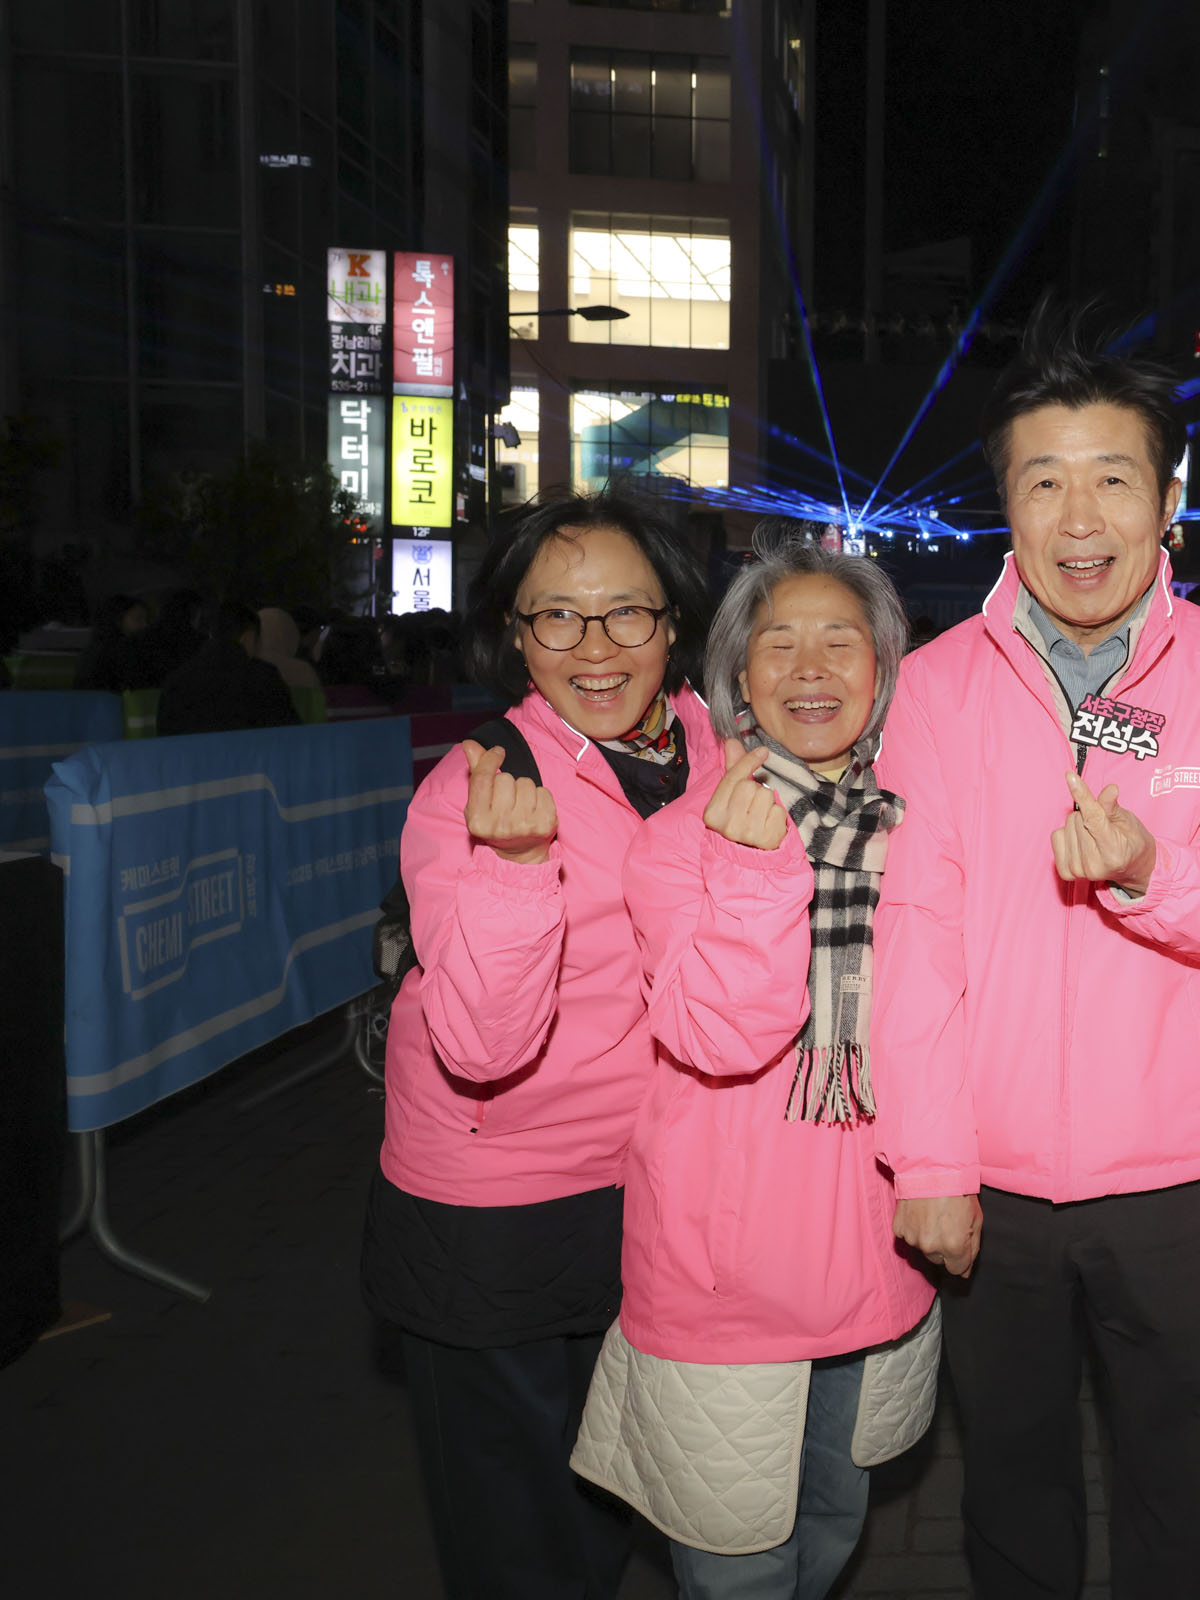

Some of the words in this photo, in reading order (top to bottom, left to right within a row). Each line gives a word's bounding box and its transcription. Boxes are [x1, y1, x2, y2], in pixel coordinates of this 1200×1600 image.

[347, 253, 371, 277] K
[331, 280, 383, 305] 내과
[411, 260, 436, 376] 톡스앤필
[331, 351, 383, 379] 치과
[409, 417, 437, 504] 바로코
[412, 526, 430, 537] 12F
[1071, 710, 1158, 760] 전성수
[1081, 694, 1165, 733] 서초구청장
[187, 871, 234, 927] STREET
[136, 911, 183, 974] CHEMI
